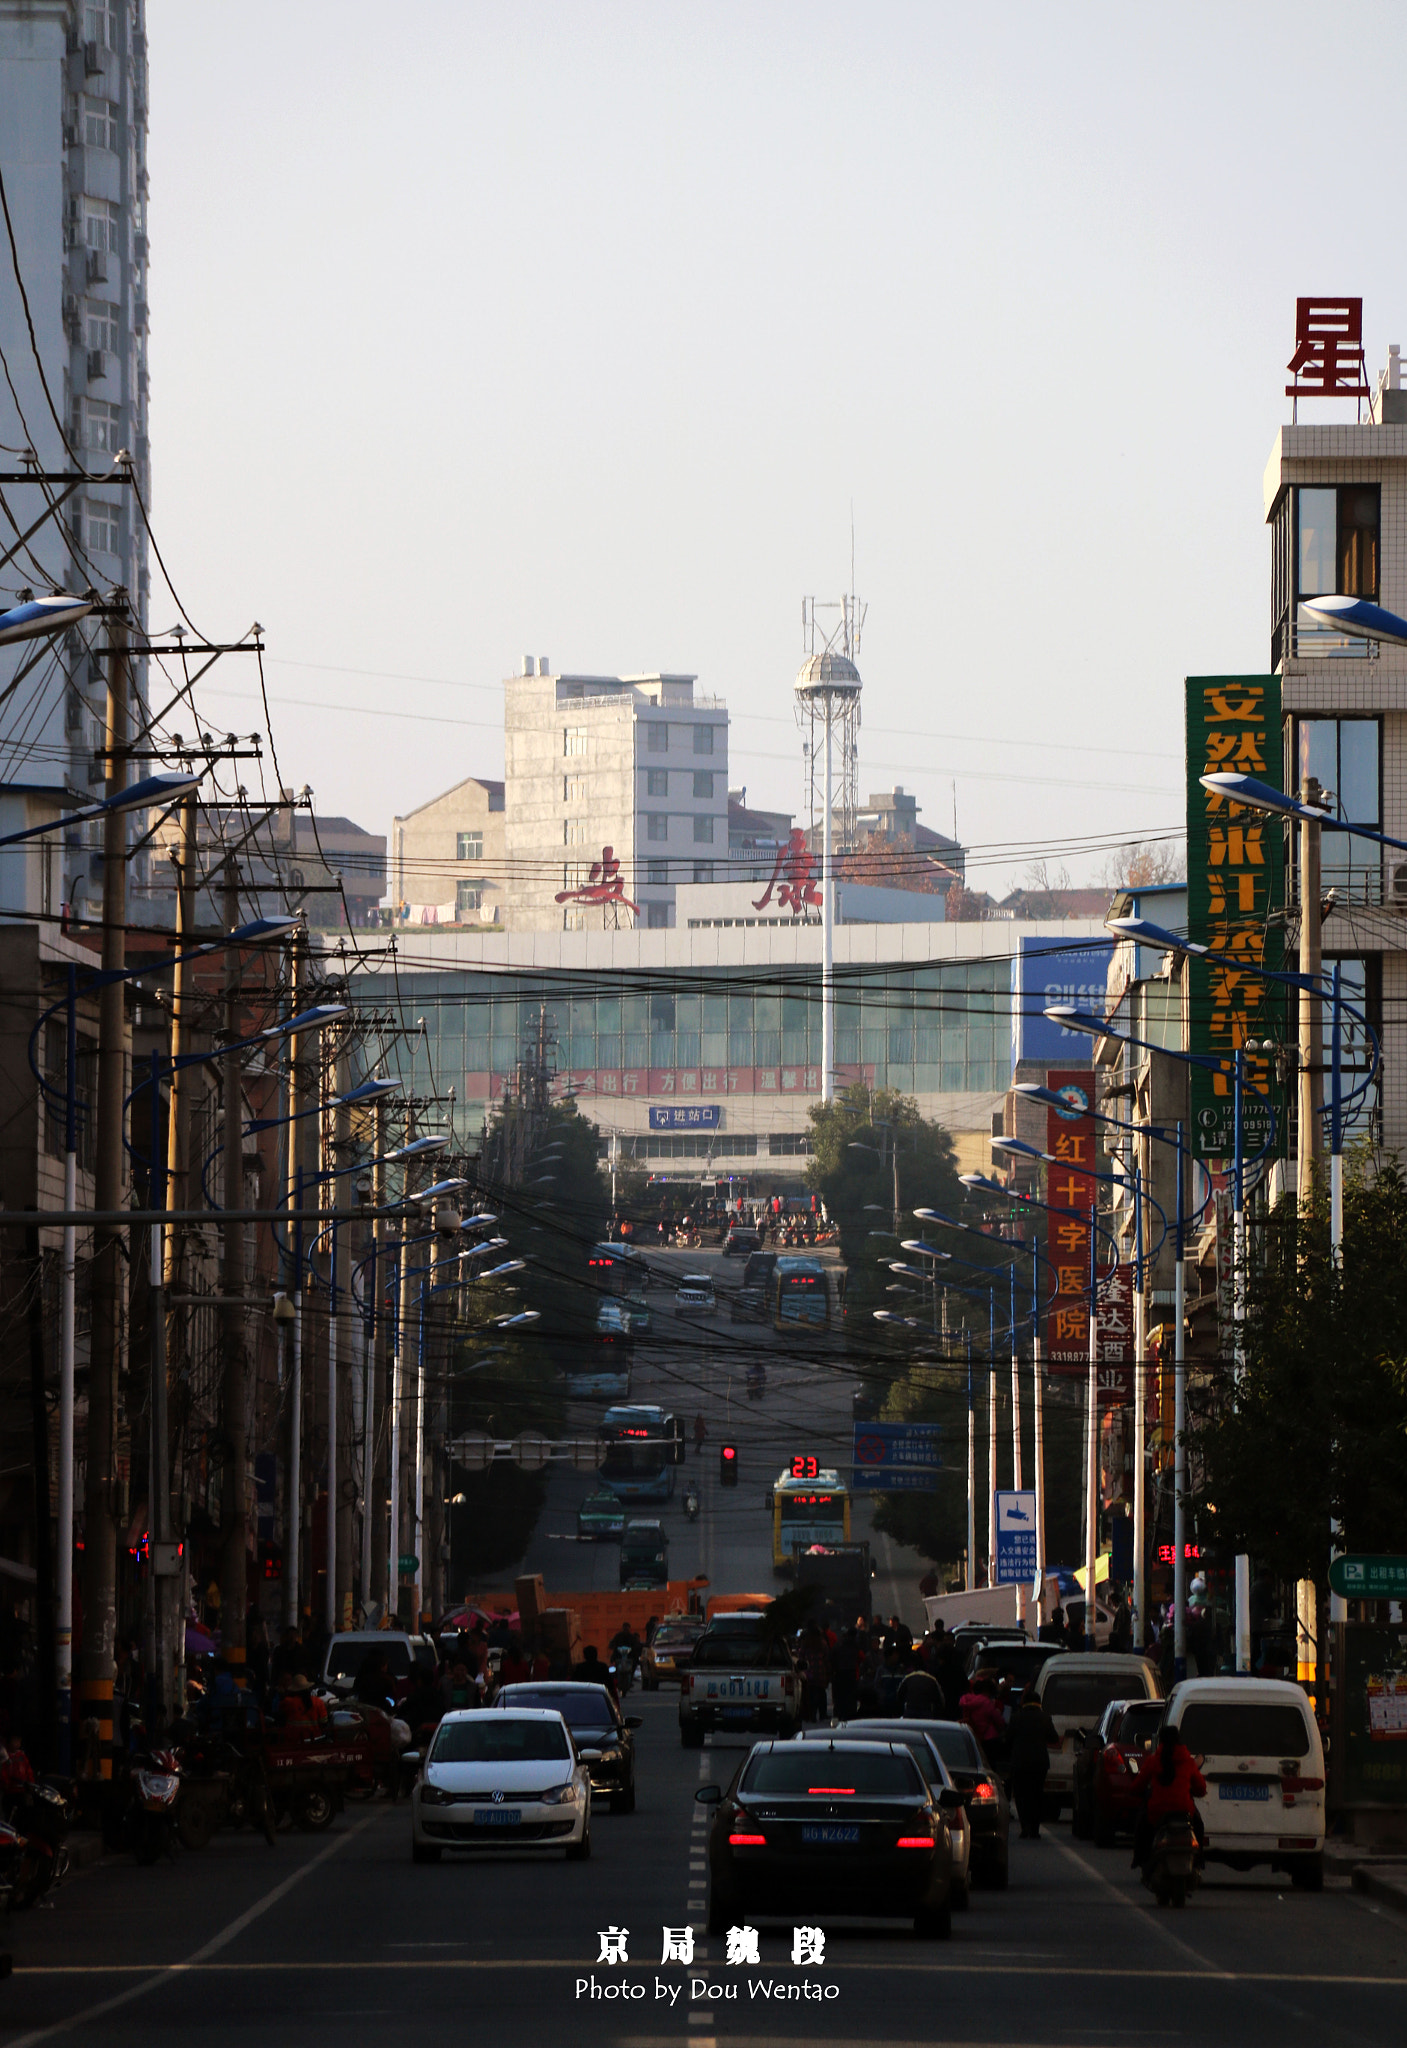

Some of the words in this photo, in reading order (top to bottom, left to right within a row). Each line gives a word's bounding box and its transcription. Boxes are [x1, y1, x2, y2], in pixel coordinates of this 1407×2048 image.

[1285, 297, 1371, 397] 星
[661, 1072, 739, 1092] 方便出行
[761, 1070, 839, 1090] 温馨出
[674, 1108, 713, 1122] 进站口
[1212, 1131, 1278, 1147] 请三楼
[1055, 1133, 1087, 1340] 红十字医院
[793, 1456, 817, 1478] 23
[1370, 1566, 1407, 1580] 出租车临
